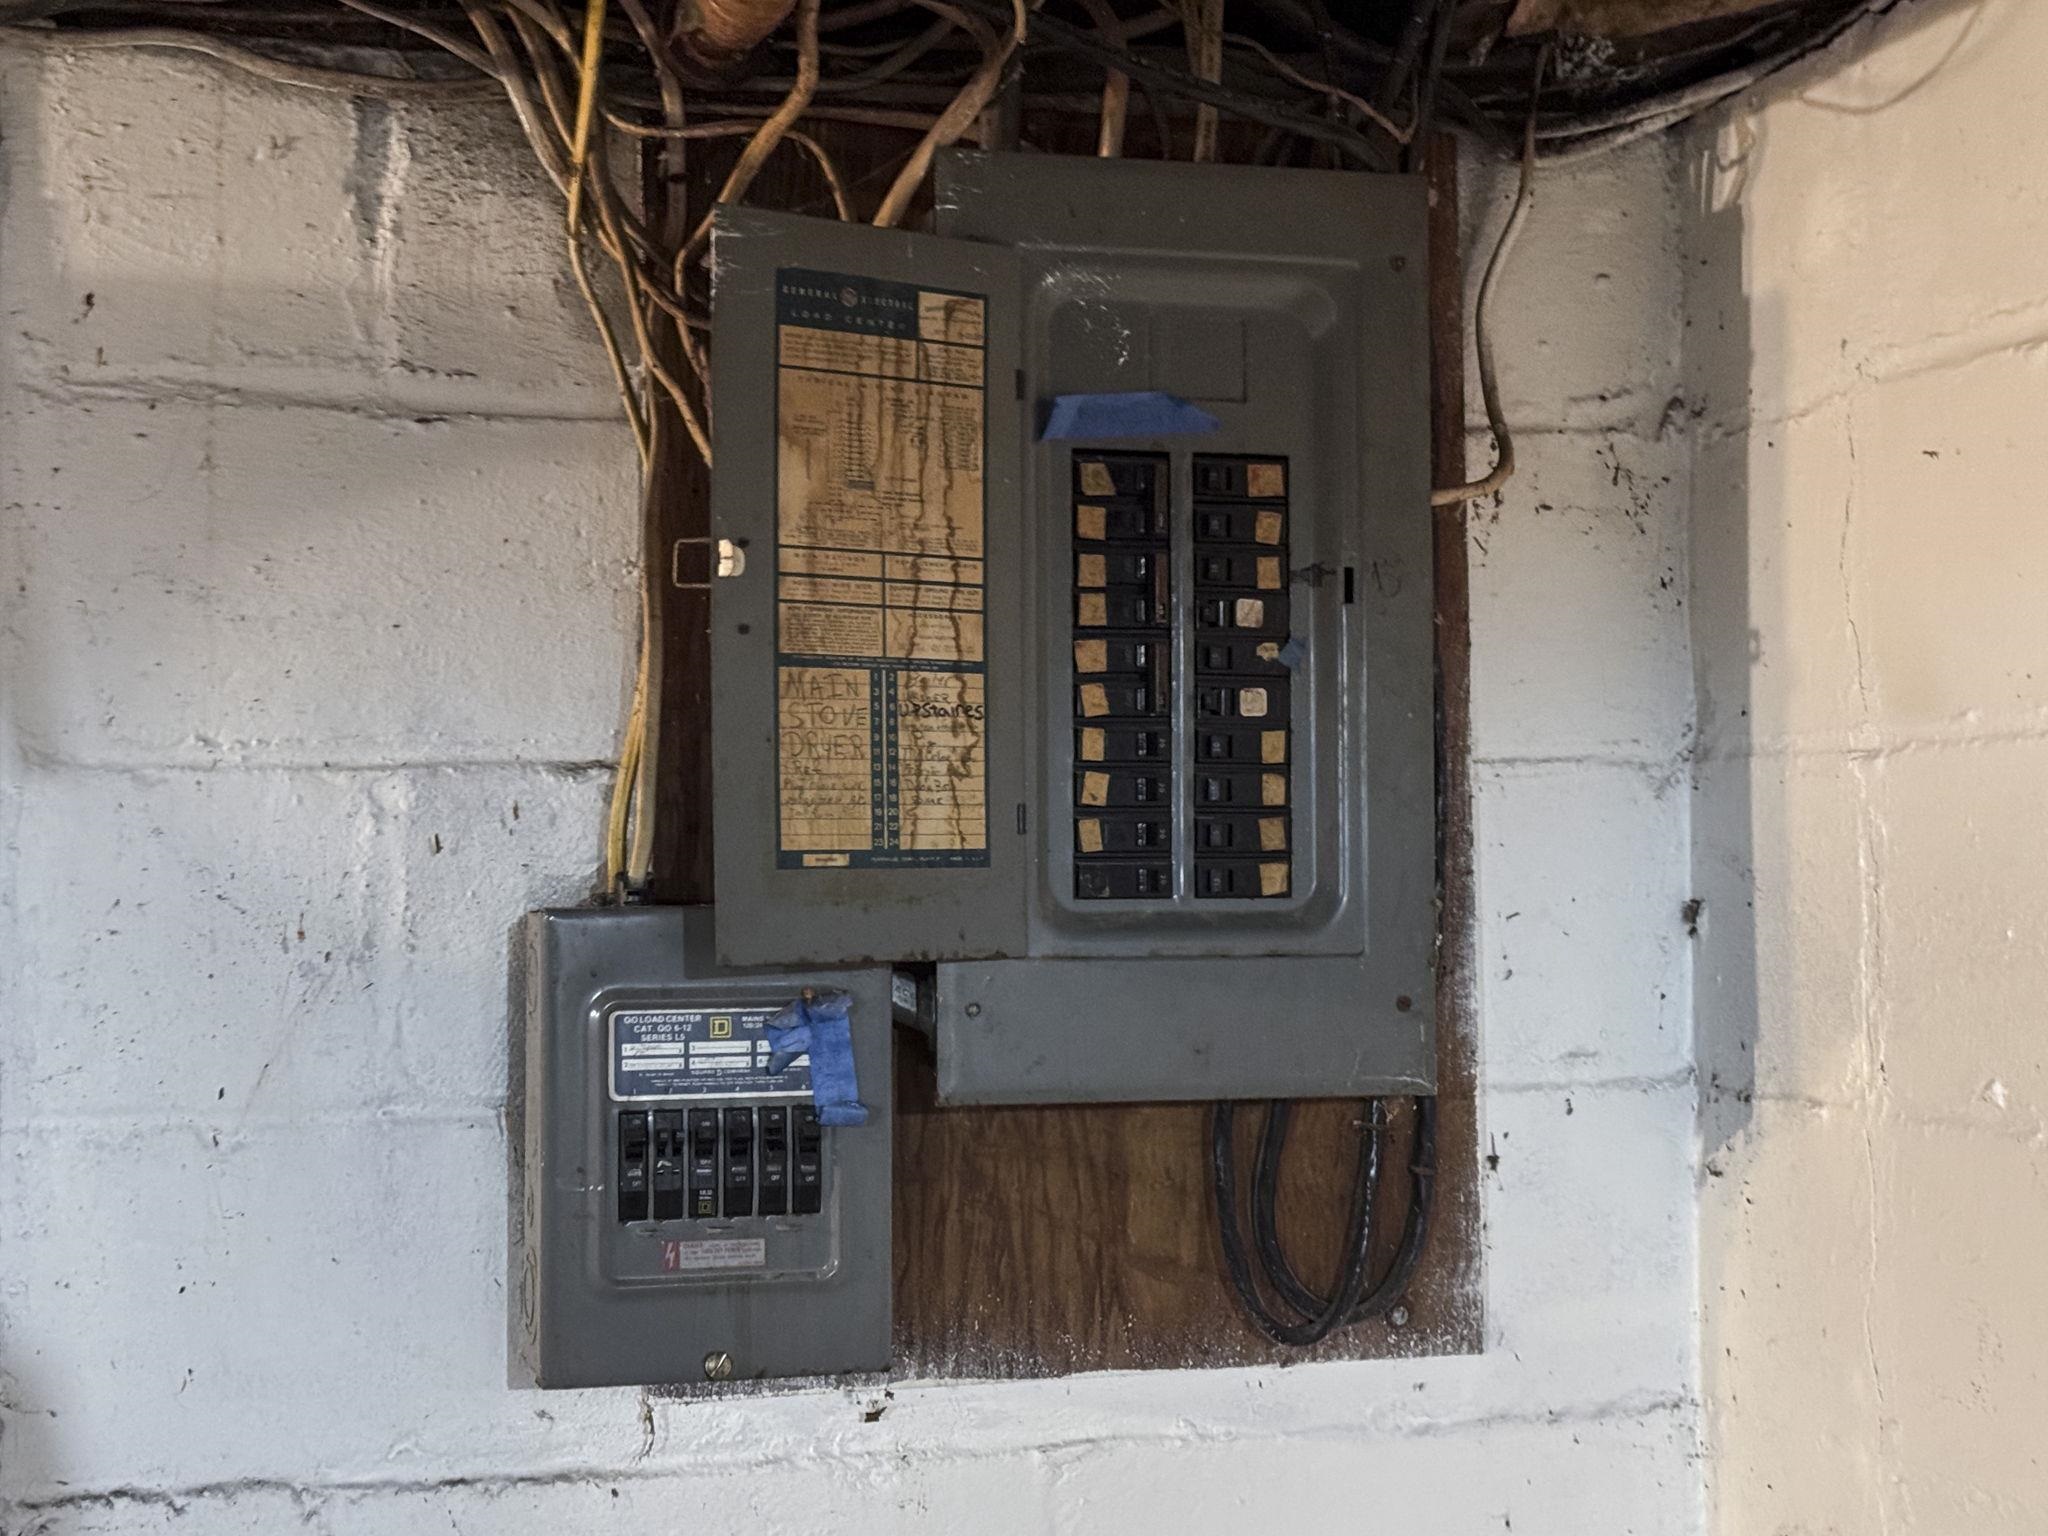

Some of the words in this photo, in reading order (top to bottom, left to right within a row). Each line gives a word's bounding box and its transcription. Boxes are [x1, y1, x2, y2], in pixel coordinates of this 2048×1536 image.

[785, 670, 860, 700] MAIN
[786, 702, 868, 729] STOVE
[781, 731, 866, 760] DRYER
[639, 1015, 665, 1023] LOAD
[665, 1014, 702, 1023] CENTER
[640, 1034, 673, 1042] SERIES
